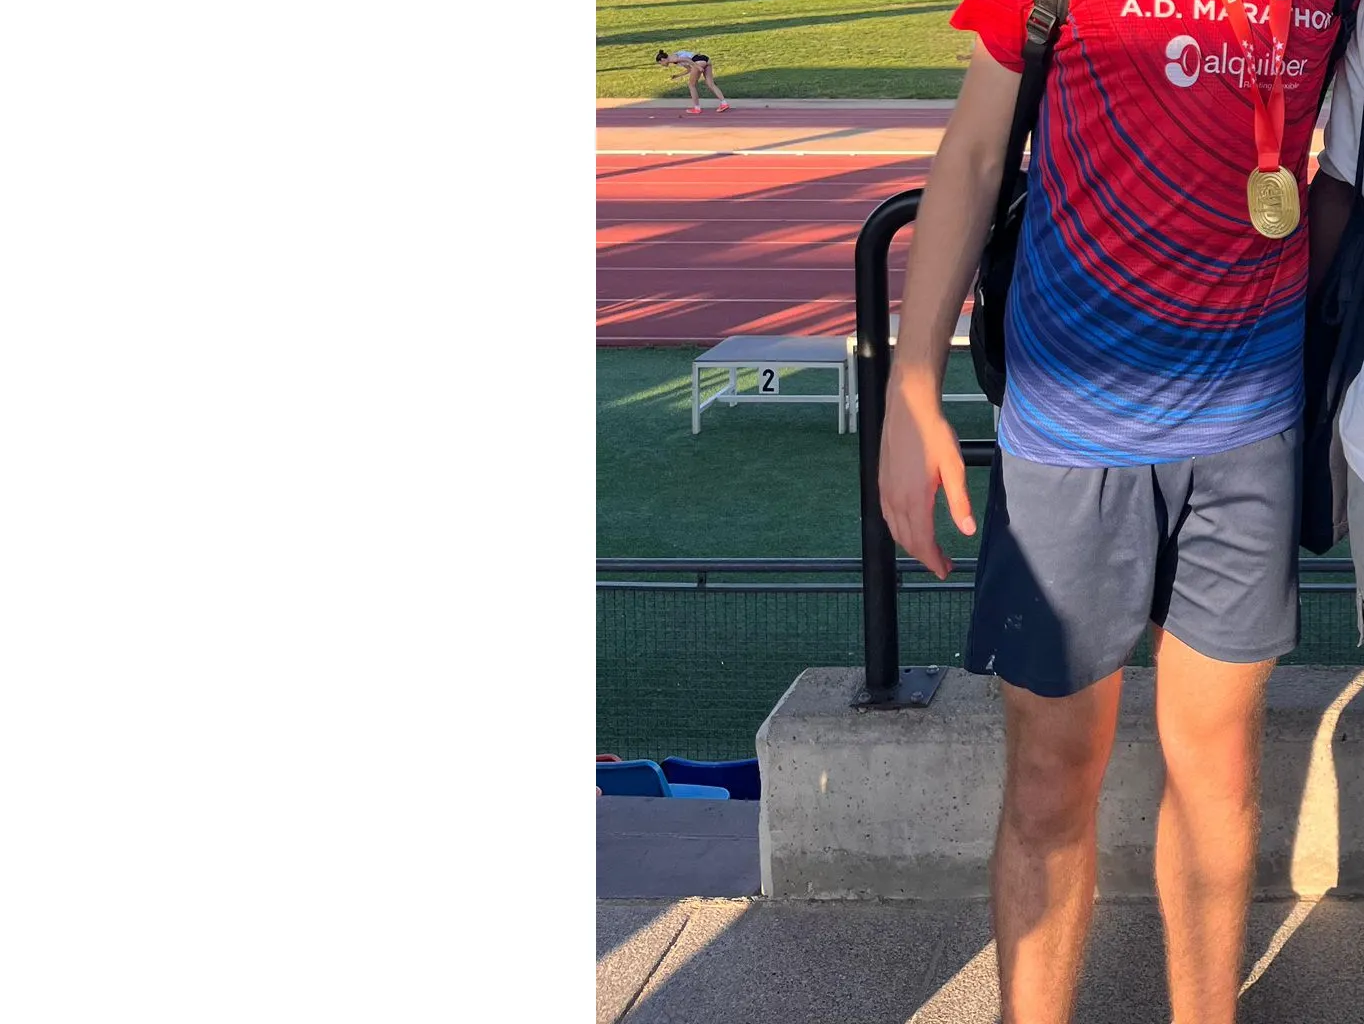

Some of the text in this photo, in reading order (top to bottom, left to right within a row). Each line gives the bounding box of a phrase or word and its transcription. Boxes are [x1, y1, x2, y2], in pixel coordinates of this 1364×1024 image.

[1193, 0, 1334, 30] MRHON
[1203, 42, 1308, 89] alquiber
[1243, 81, 1273, 91] Rting
[762, 368, 775, 392] 2
